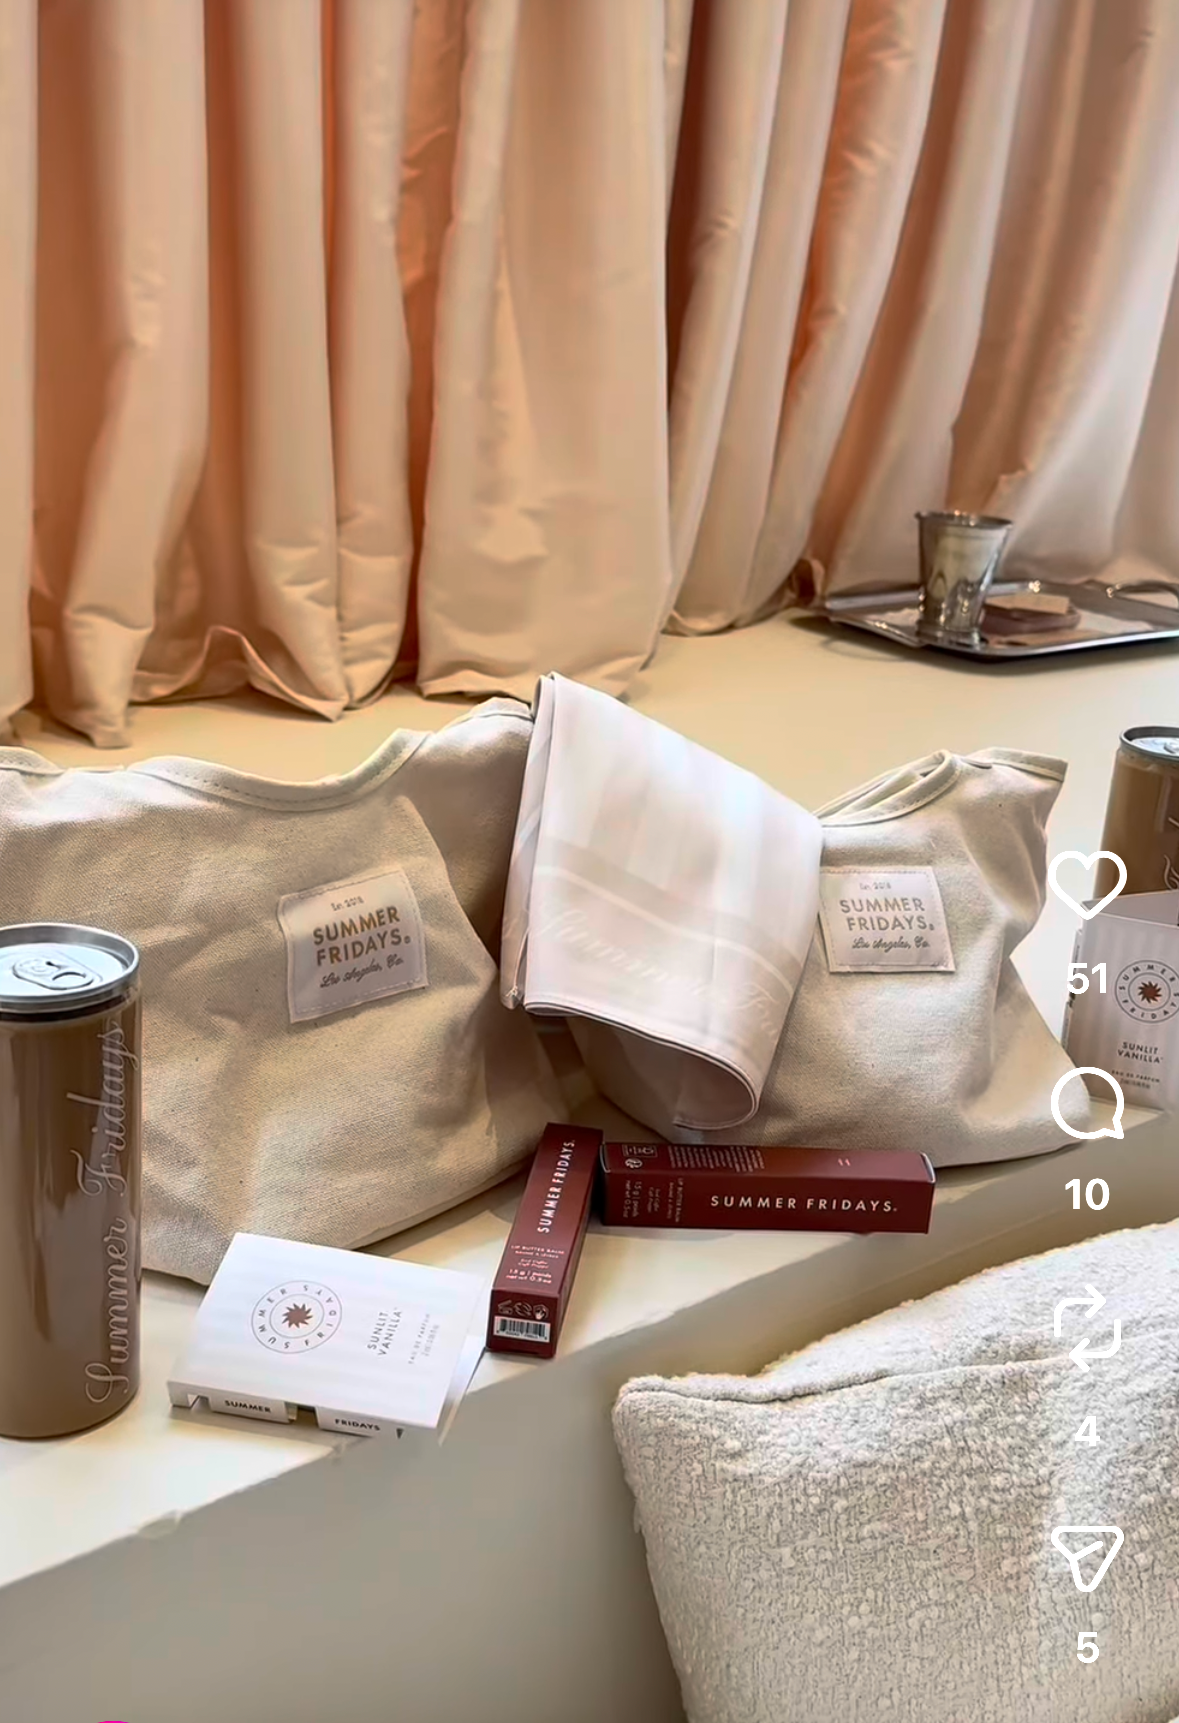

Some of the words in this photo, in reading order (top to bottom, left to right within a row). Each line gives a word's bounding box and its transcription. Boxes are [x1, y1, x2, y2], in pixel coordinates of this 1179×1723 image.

[839, 897, 925, 913] SUMMER
[313, 905, 400, 946] SUMMER
[1122, 1041, 1159, 1055] SUNLIT
[66, 1020, 140, 1196] Fridays
[537, 1186, 562, 1234] SUMMER
[710, 1195, 797, 1209] SUMMER
[85, 1217, 129, 1403] Summer
[366, 1311, 388, 1350] SUNLIT
[224, 1400, 271, 1414] SUMMER
[334, 1418, 381, 1432] FRIDAYS
